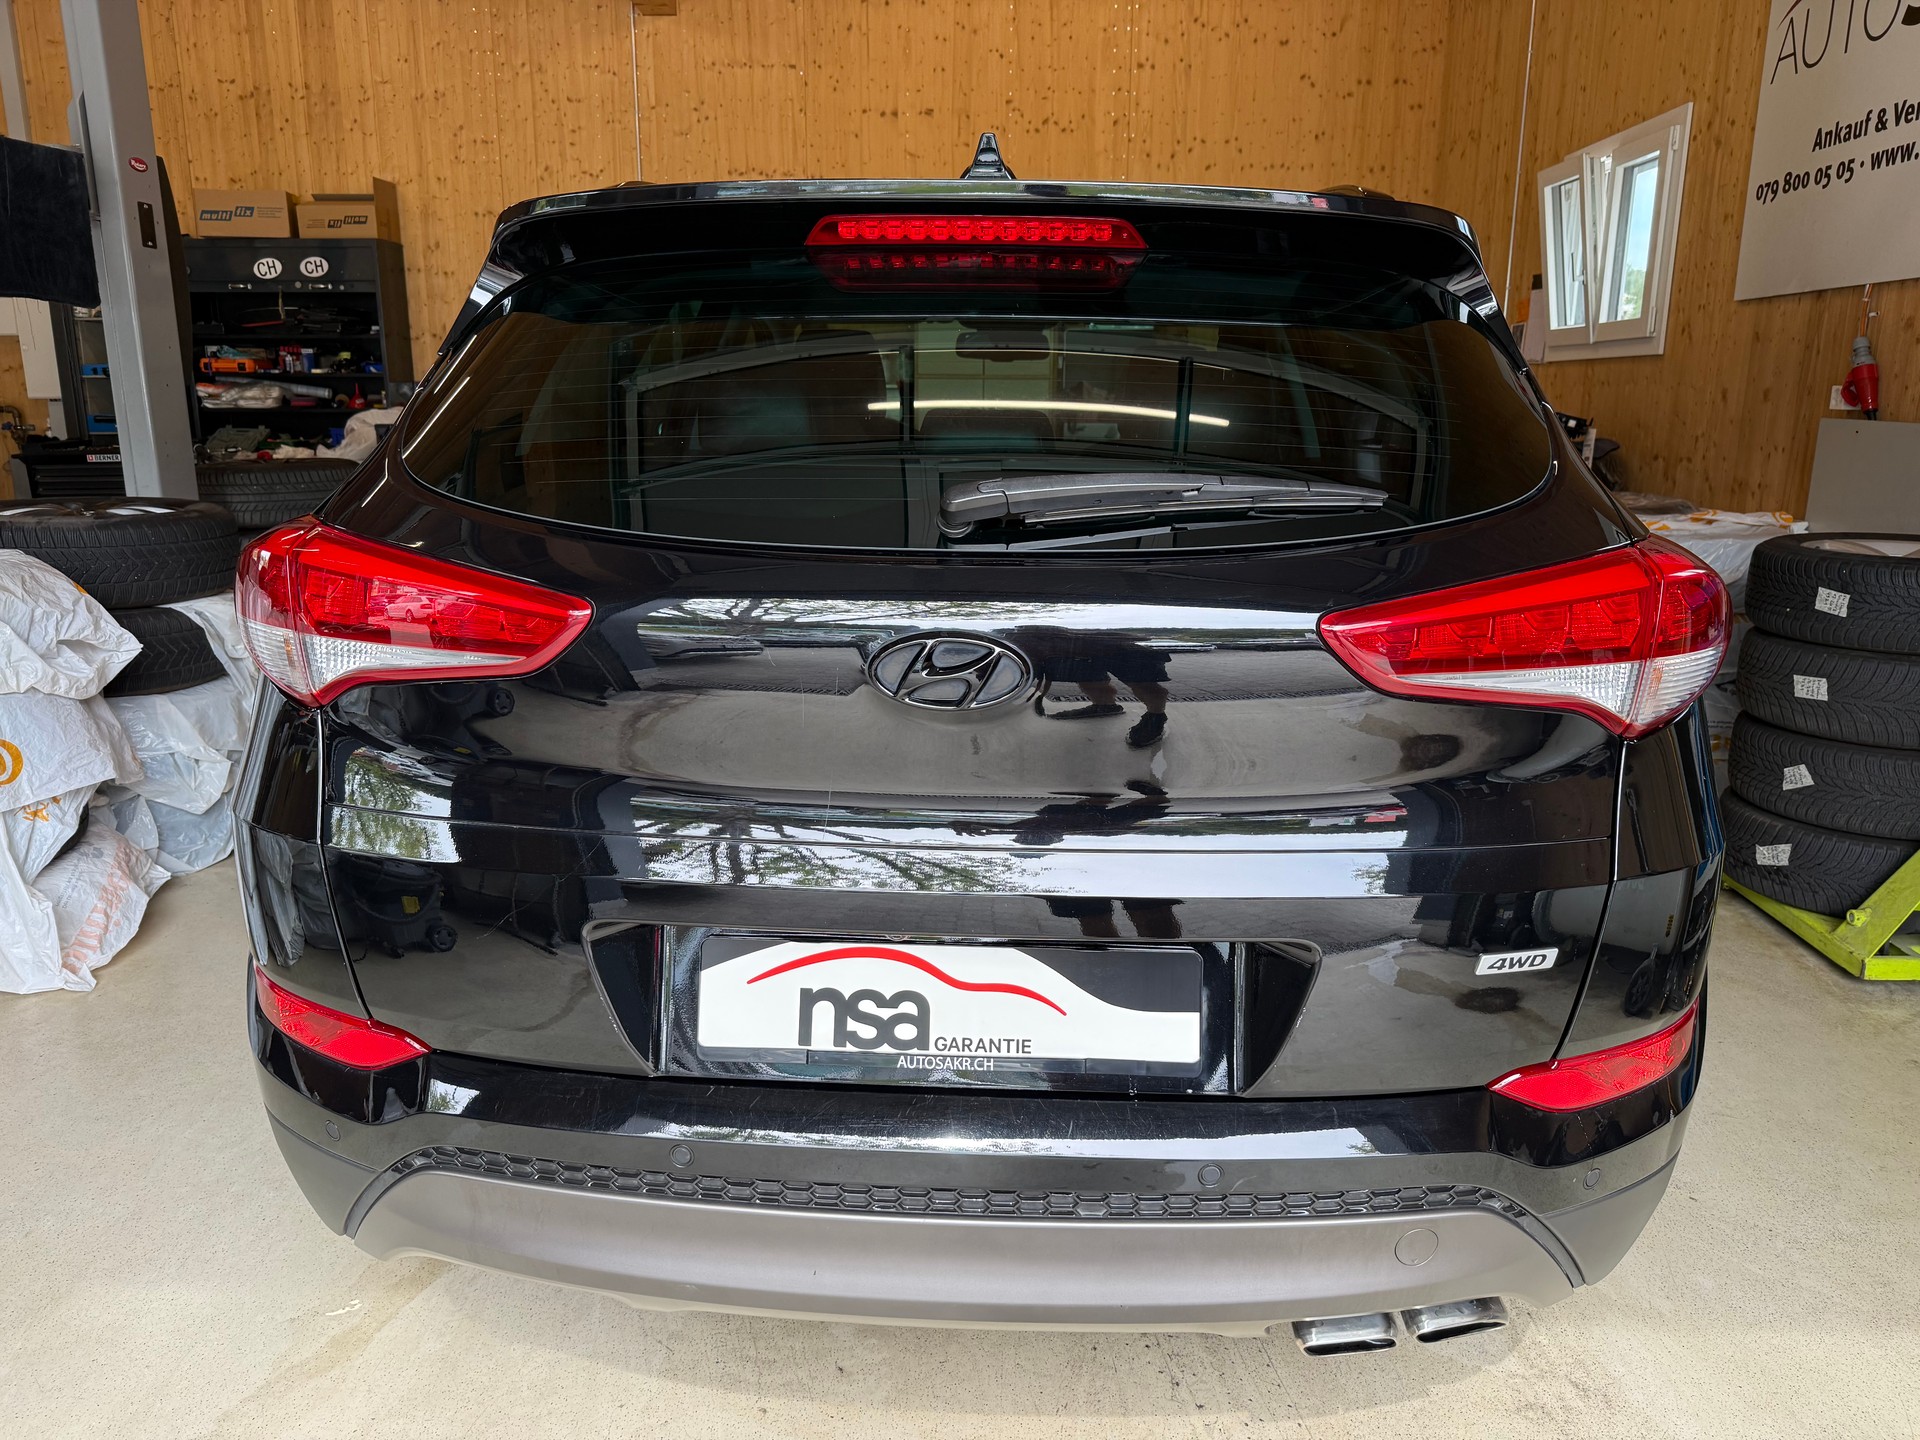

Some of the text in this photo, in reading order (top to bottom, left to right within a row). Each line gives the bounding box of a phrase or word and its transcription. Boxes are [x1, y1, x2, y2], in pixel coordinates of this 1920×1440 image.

[1812, 109, 1873, 152] Ankauf
[1875, 108, 1888, 133] &
[1756, 179, 1779, 205] 079
[1782, 171, 1810, 194] 800
[1814, 164, 1833, 189] 05
[1836, 158, 1855, 184] 05
[201, 210, 232, 220] multi
[235, 207, 253, 216] fix
[257, 260, 278, 277] CH
[304, 259, 324, 275] CH
[1487, 954, 1547, 970] 4WD
[798, 987, 1032, 1054] nsa GARANTIE
[897, 1055, 994, 1071] AUTOSAKR.CH
